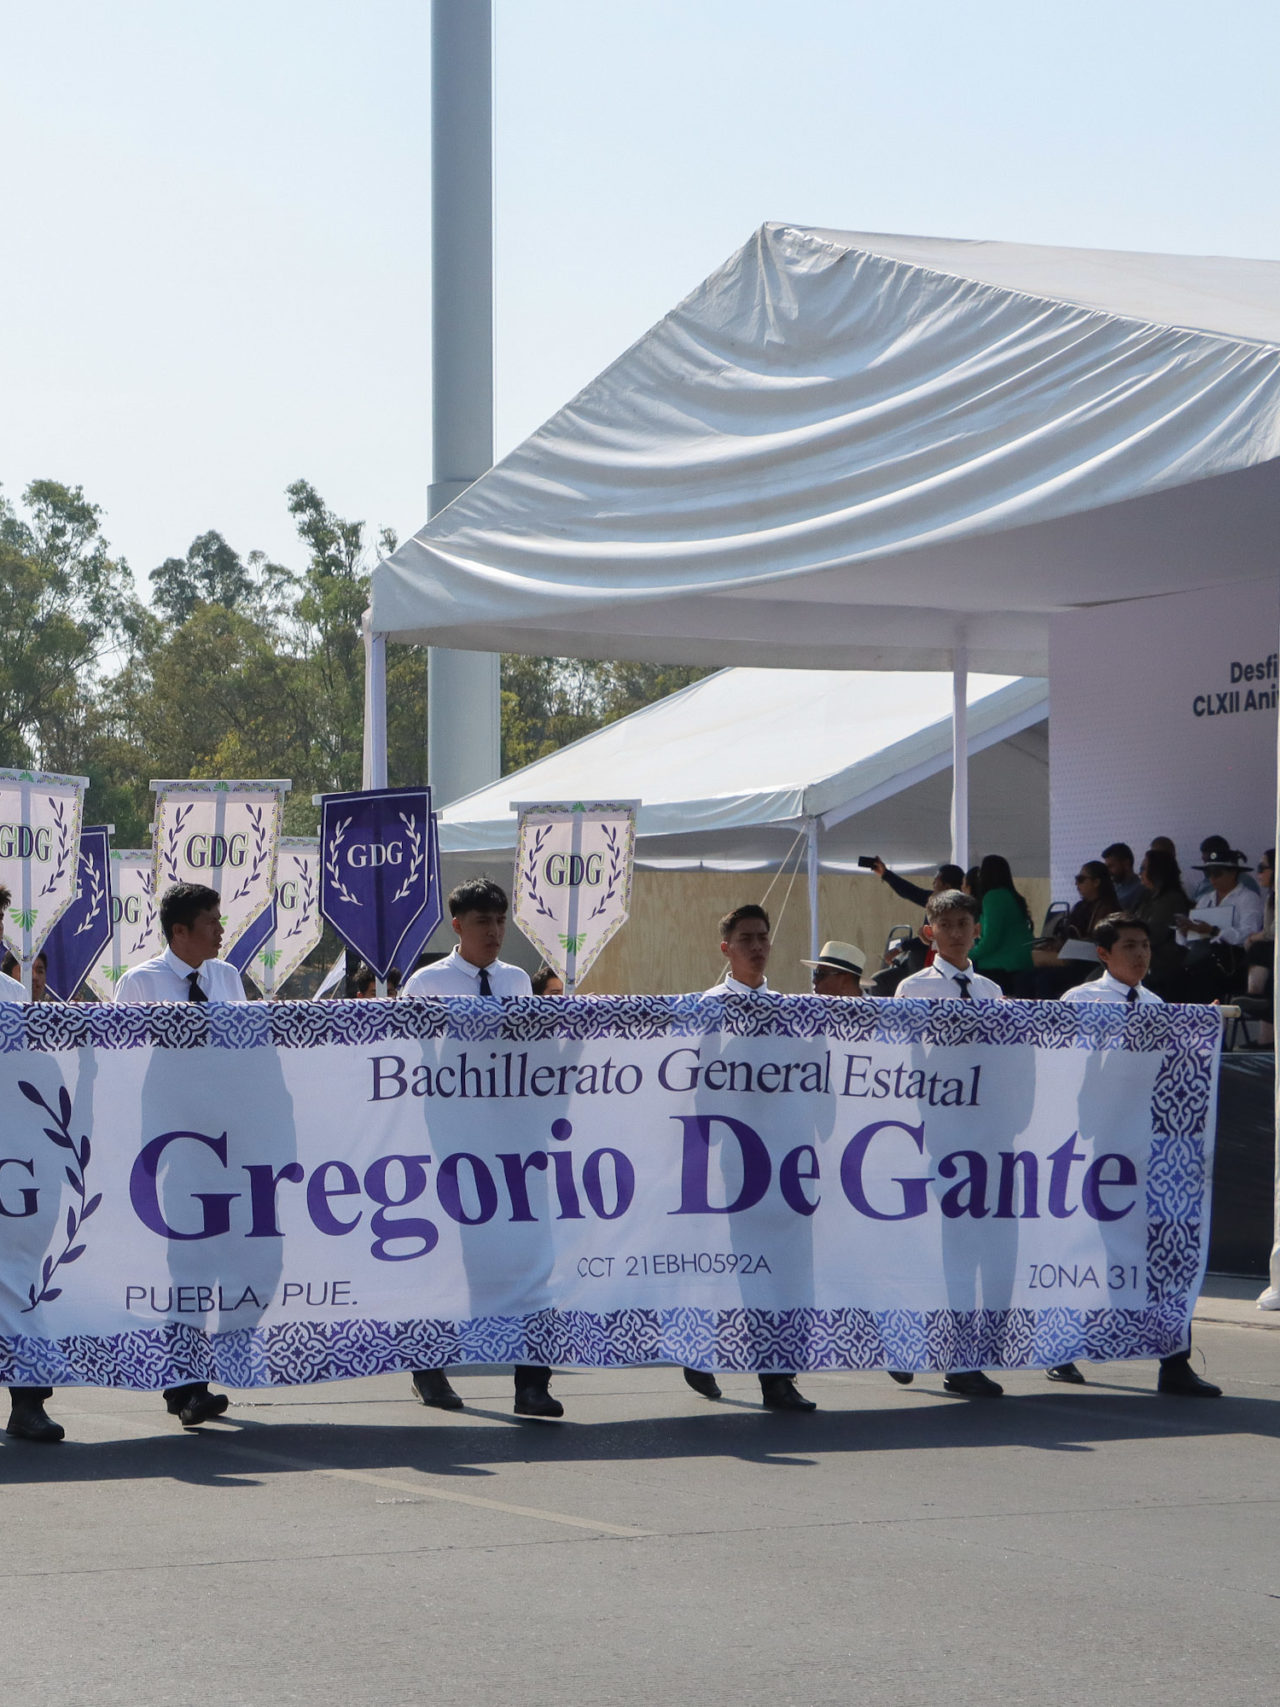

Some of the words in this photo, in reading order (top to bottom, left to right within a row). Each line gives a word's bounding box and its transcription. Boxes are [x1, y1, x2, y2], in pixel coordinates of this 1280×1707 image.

[1193, 691, 1240, 717] CLXII
[1244, 684, 1279, 711] Ani
[186, 834, 248, 869] GDG
[346, 842, 404, 868] GDG
[544, 853, 604, 887] GDG
[367, 1051, 643, 1102] Bachillerato
[657, 1047, 830, 1095] General
[839, 1053, 982, 1107] Estatal
[129, 1117, 636, 1262] Gregorio
[666, 1114, 821, 1217] De
[838, 1120, 1139, 1222] Gante
[577, 1257, 616, 1278] CCT
[625, 1252, 773, 1277] 21EBH0592A
[1028, 1263, 1100, 1289] ZONA
[1108, 1264, 1138, 1290] 31
[125, 1285, 270, 1313] PUEBLA,
[281, 1280, 358, 1307] PUE.
